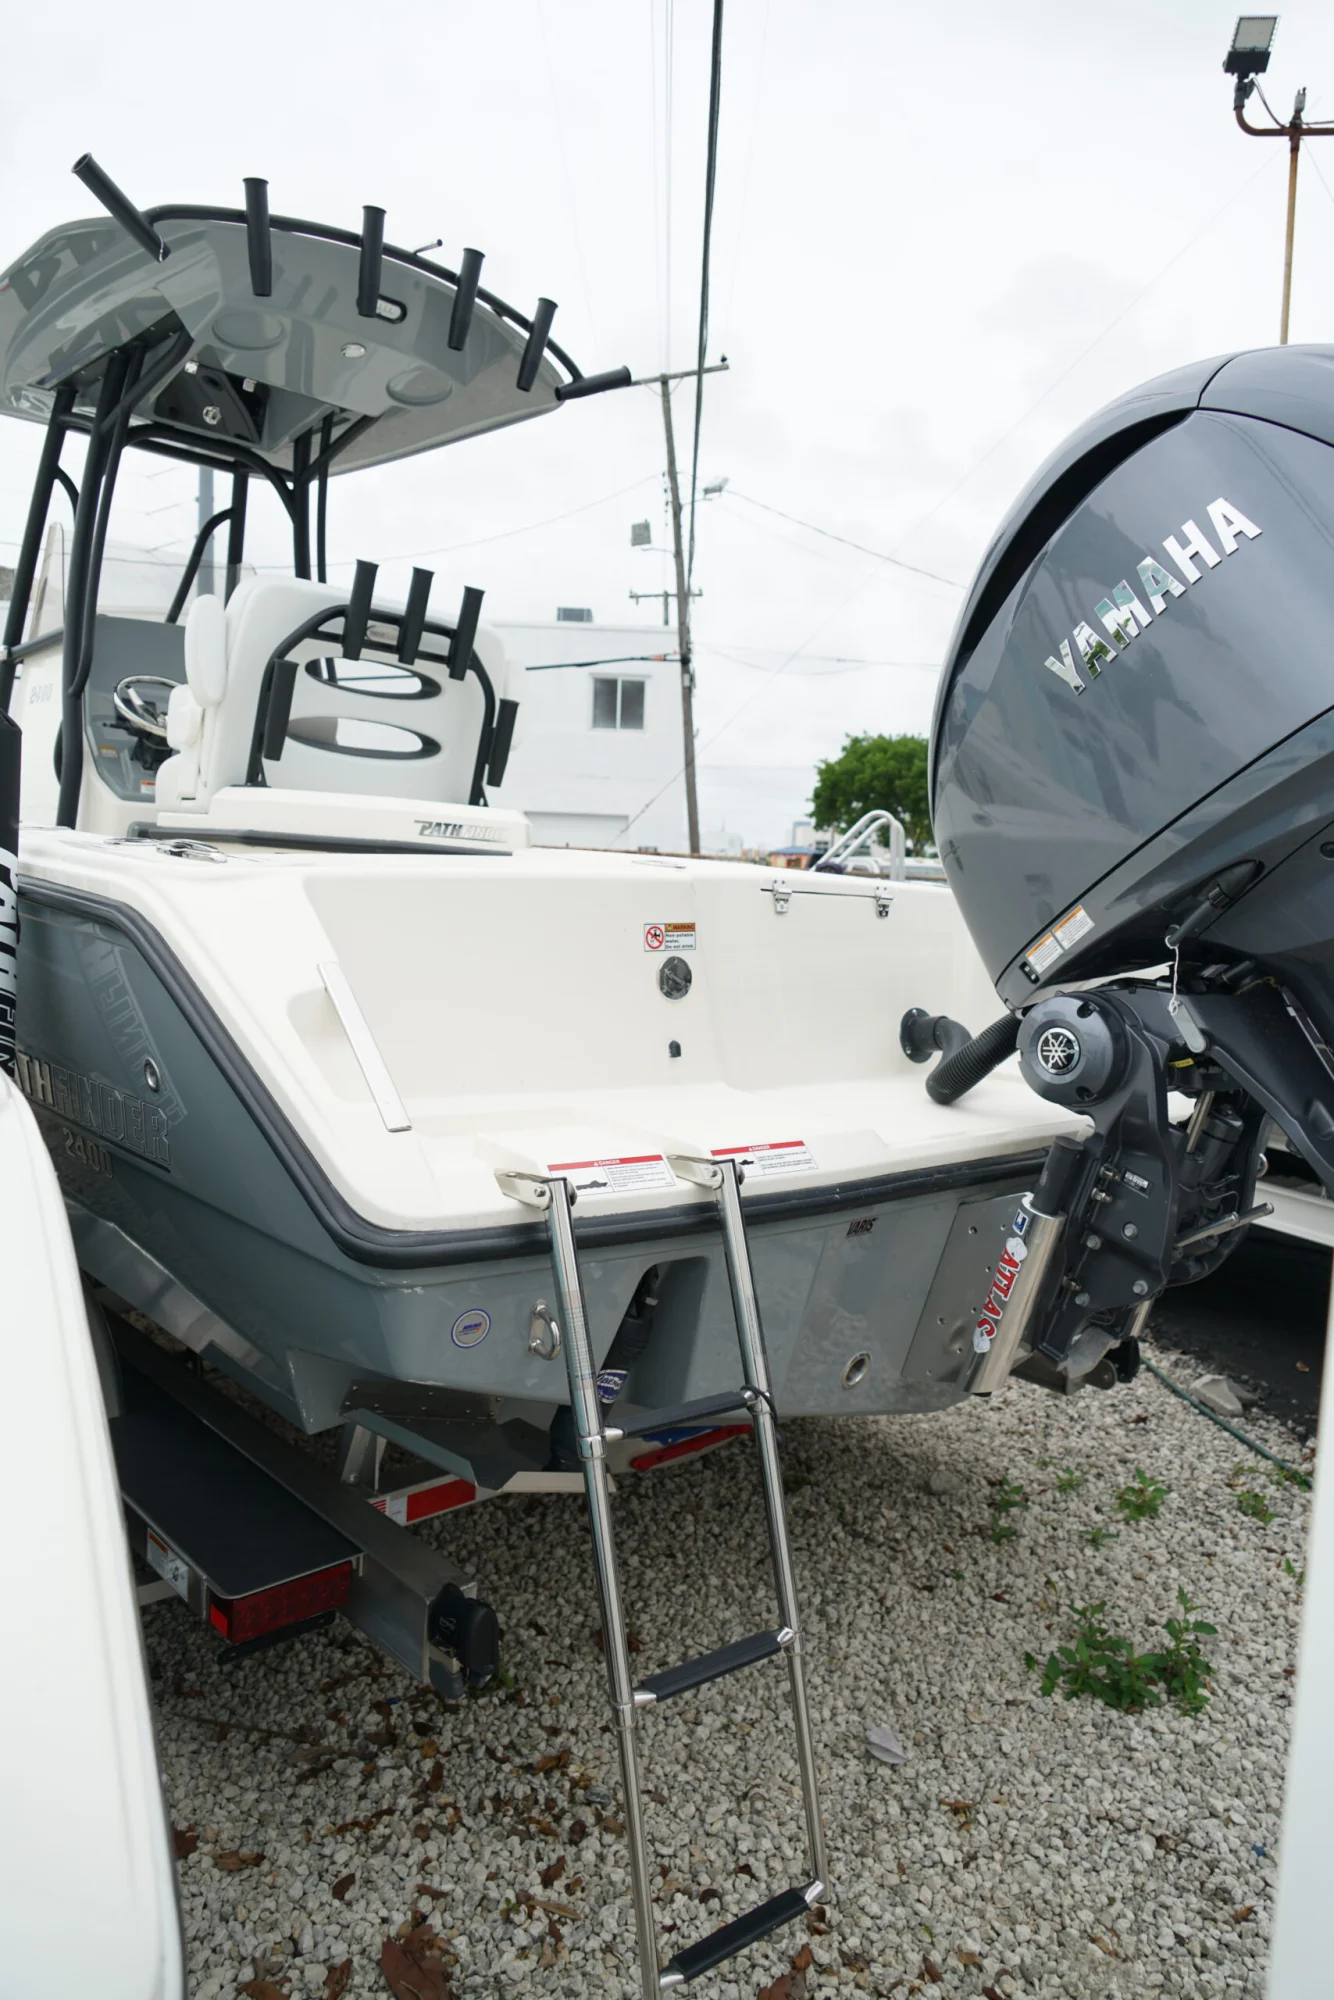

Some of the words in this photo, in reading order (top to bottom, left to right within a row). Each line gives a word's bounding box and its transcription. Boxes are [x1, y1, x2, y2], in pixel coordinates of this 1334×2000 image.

[1044, 497, 1263, 696] YAMAHA
[14, 1052, 171, 1167] THFINDER
[63, 1127, 114, 1180] 2400
[976, 1246, 1022, 1339] ATLAS
